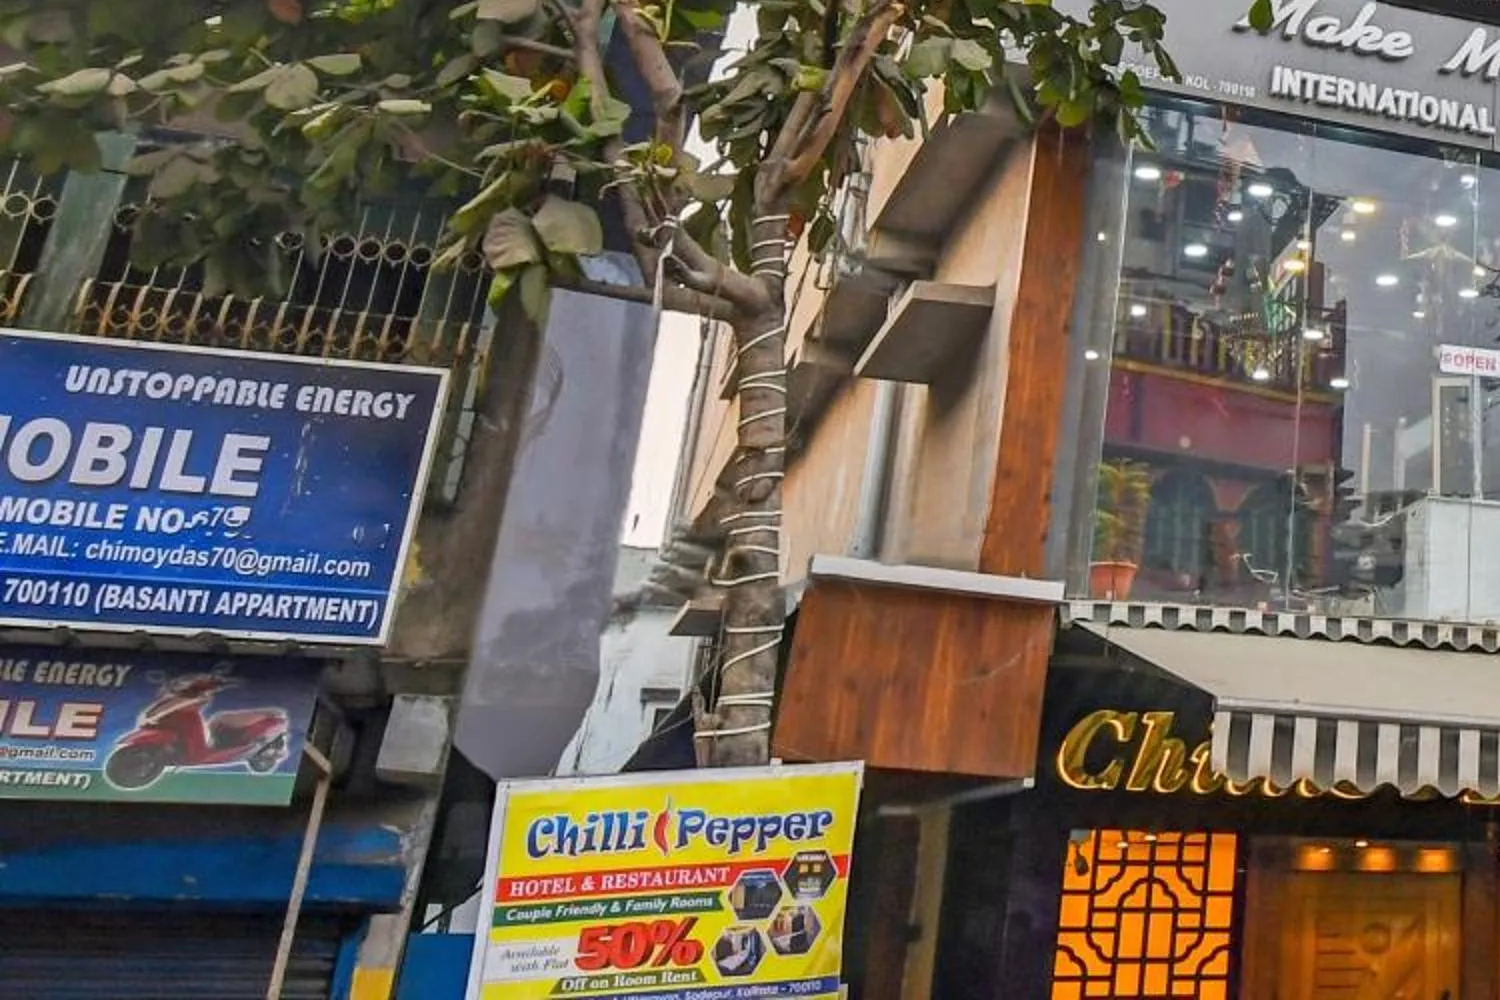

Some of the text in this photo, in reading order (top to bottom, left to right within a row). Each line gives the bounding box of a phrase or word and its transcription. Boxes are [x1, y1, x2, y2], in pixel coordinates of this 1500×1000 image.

[1271, 66, 1495, 134] INTERNATIONAL
[65, 365, 416, 420] UNSTOPPABLE ENERGY
[0, 415, 271, 497] OBILE
[86, 539, 370, 577] chimoydas70@gmail.com
[4, 579, 378, 630] 700110 (BASANTI APPARTMENT)
[34, 661, 132, 688] ENERGY
[528, 809, 834, 858] Chilli Pepper
[510, 867, 731, 897] HOTEL & RESTAURANT
[506, 895, 713, 922] Couple Friendly & Family Rooms
[574, 917, 705, 971] 50%
[561, 970, 698, 991] Off on Room Rent
